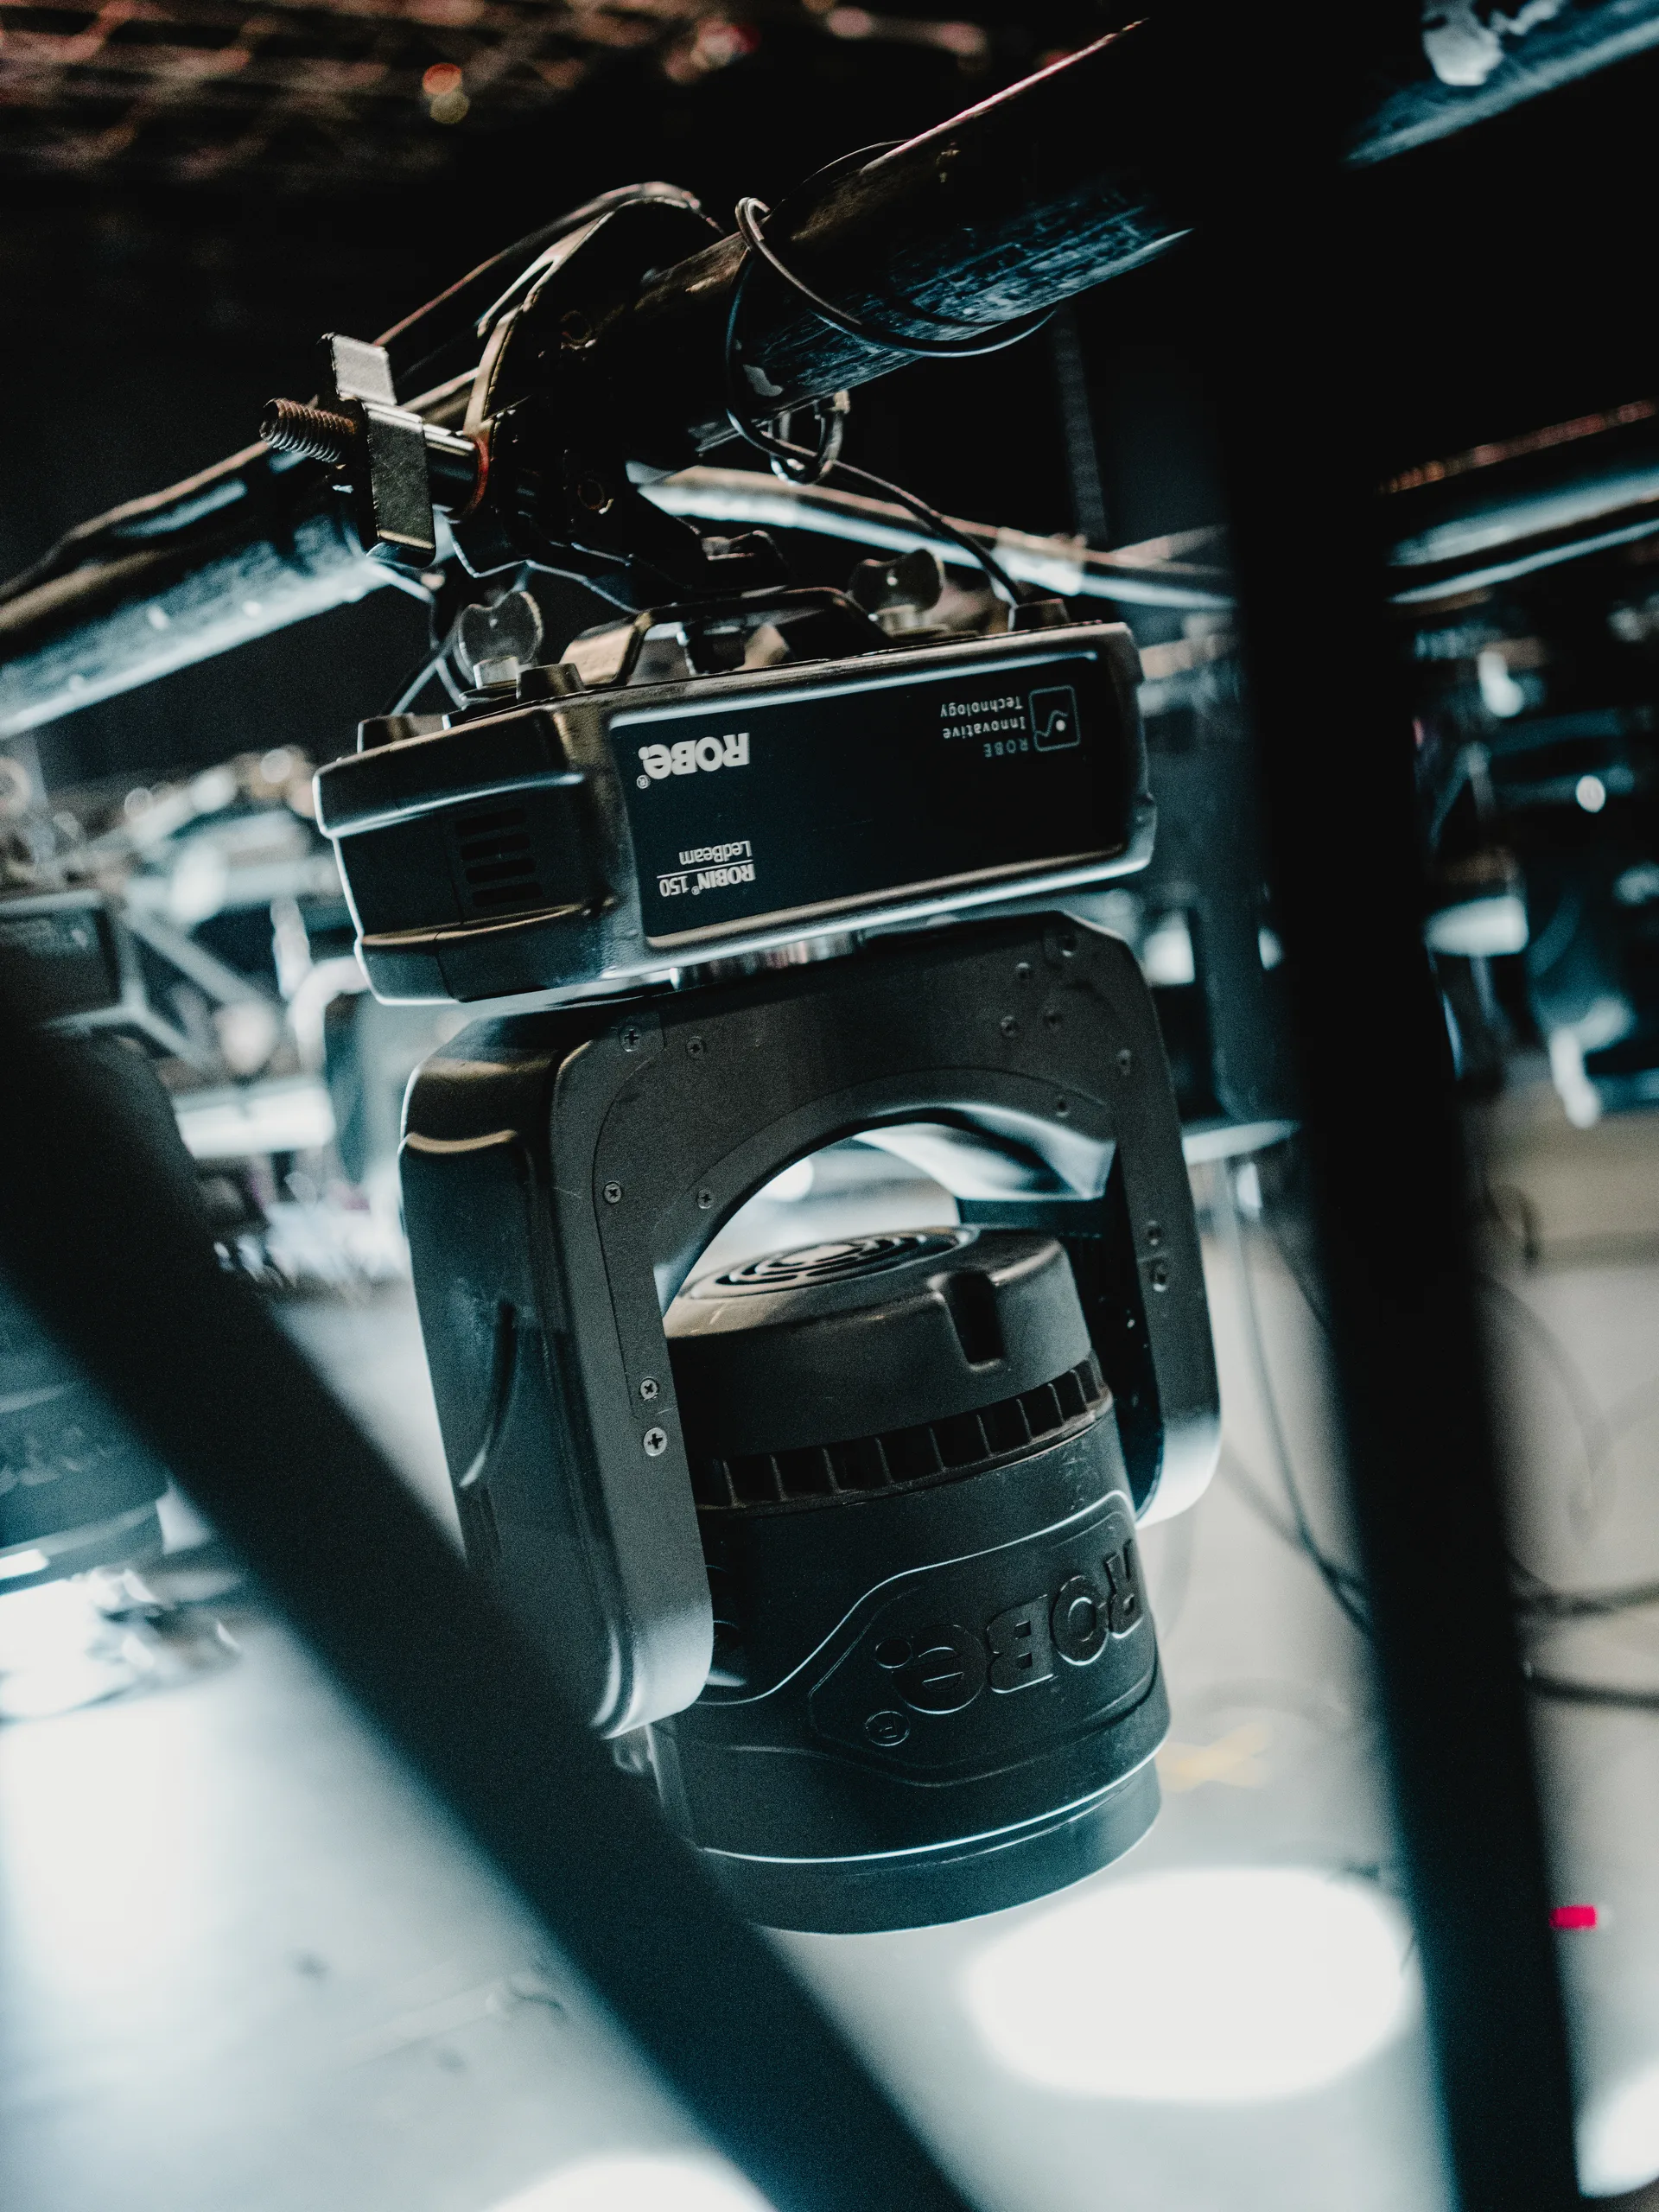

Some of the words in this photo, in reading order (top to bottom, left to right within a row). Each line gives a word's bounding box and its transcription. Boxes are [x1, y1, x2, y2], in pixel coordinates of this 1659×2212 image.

[940, 696, 1024, 717] Technology
[942, 716, 1027, 739] Innovative
[983, 737, 1029, 758] ROBE
[678, 840, 753, 865] LedBeam
[659, 875, 690, 898] 150
